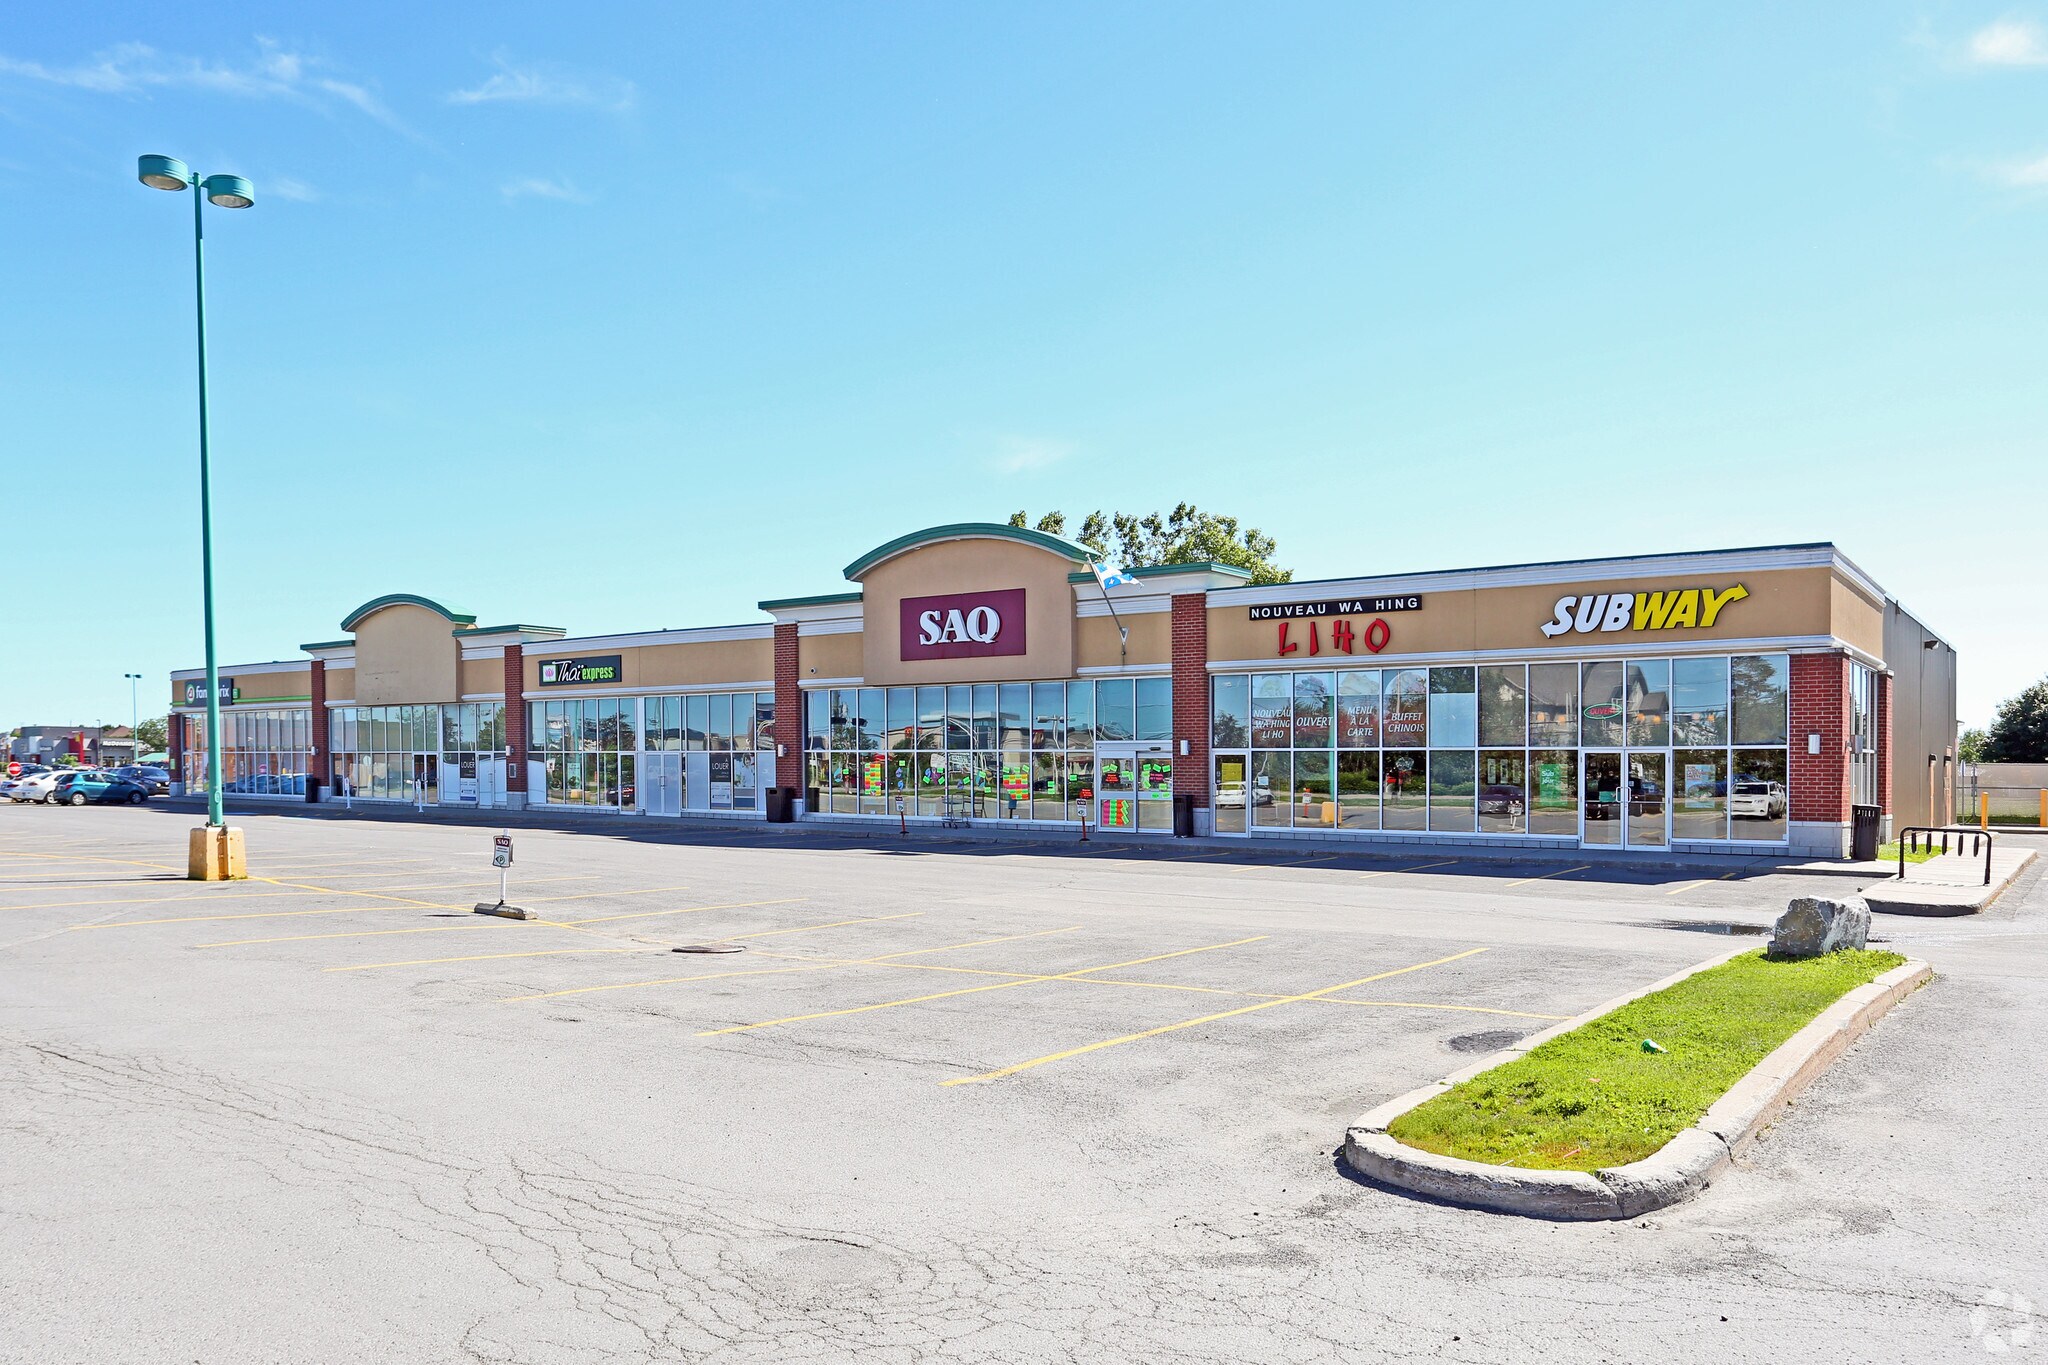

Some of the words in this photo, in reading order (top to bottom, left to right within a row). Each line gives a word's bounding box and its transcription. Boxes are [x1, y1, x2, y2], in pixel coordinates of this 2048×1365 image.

[1251, 604, 1326, 618] NOUVEAU
[1339, 601, 1363, 613] WA
[1375, 597, 1418, 611] HING
[1540, 582, 1749, 639] SUBWAY
[919, 606, 1001, 646] SAQ
[552, 660, 584, 682] Thaï
[582, 666, 613, 682] express
[1253, 709, 1291, 718] NOUVEAU
[1347, 706, 1373, 715] MENU
[1358, 717, 1370, 725] LA
[1391, 712, 1423, 721] BUFFET
[1270, 719, 1291, 728] HING
[1296, 716, 1333, 727] OUVERT
[1347, 727, 1373, 737] CARTE
[1388, 723, 1425, 733] CHINOIS
[1262, 731, 1271, 739] LI
[1271, 730, 1284, 739] HO
[711, 762, 729, 770] LOUER
